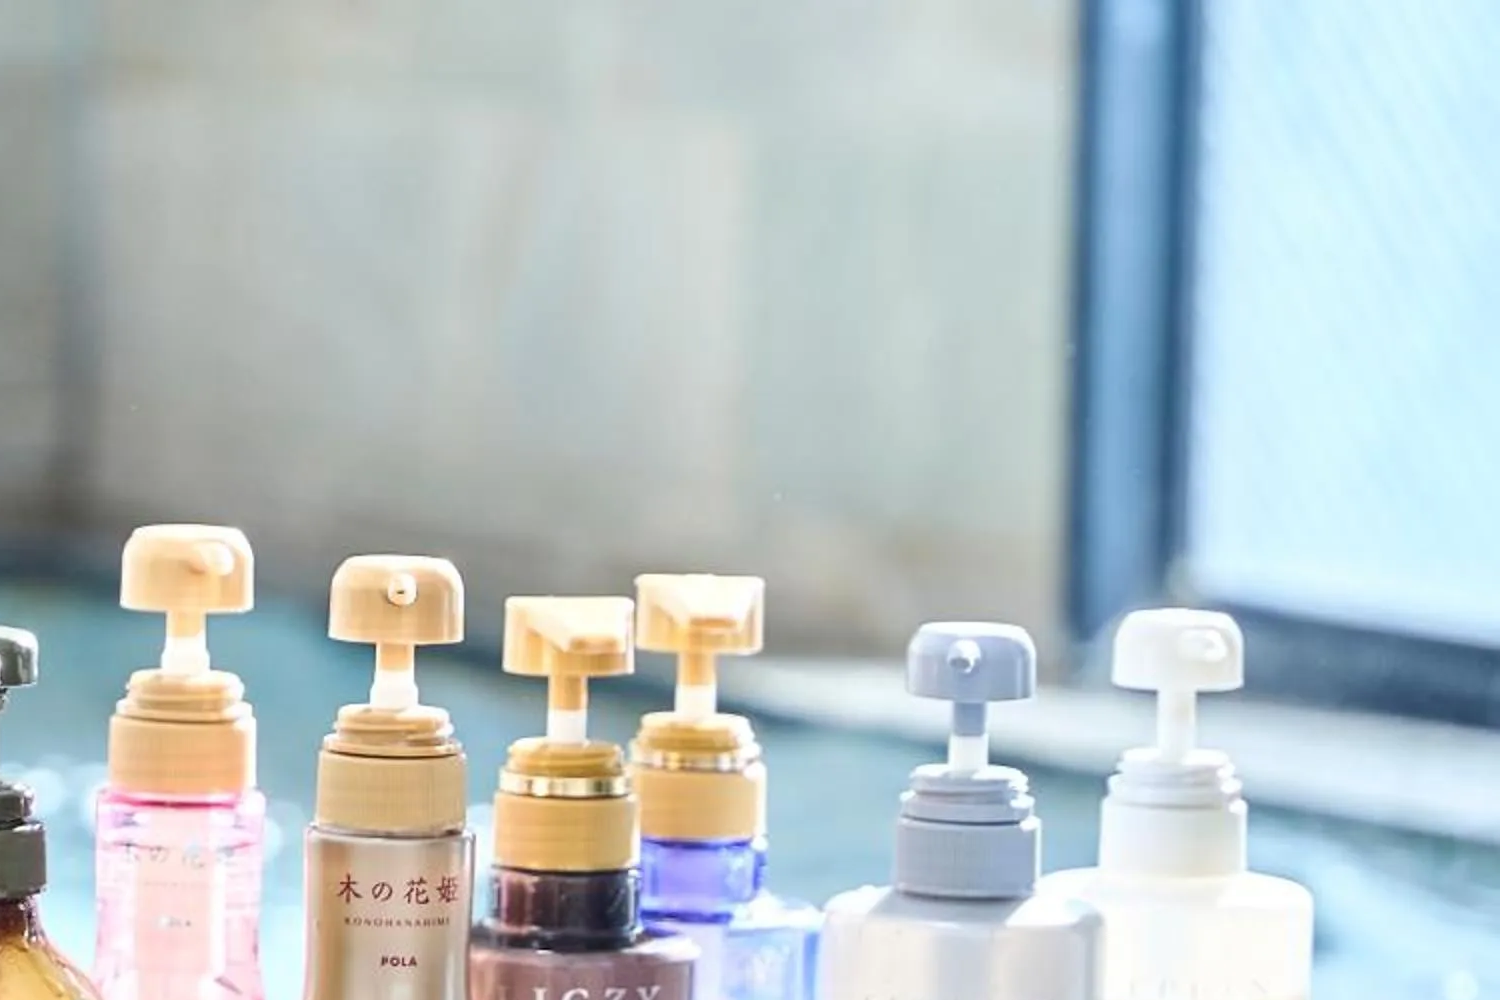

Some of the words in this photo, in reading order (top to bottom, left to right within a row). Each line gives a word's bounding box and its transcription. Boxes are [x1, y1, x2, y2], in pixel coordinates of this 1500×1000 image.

[336, 873, 459, 904] 木の花姫
[381, 956, 418, 968] POLA
